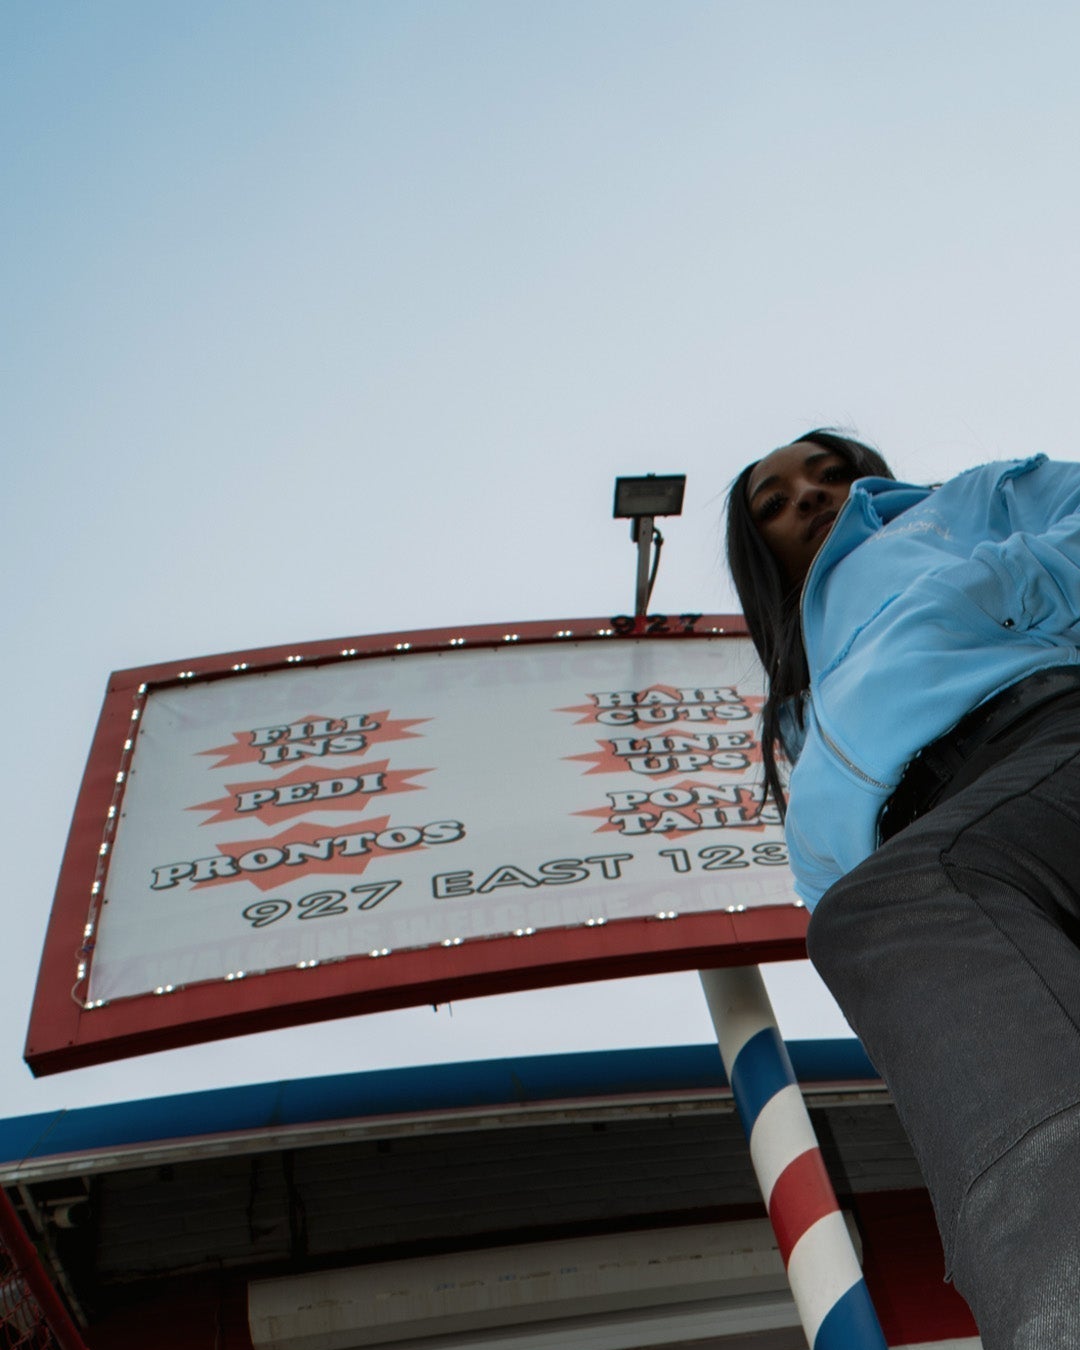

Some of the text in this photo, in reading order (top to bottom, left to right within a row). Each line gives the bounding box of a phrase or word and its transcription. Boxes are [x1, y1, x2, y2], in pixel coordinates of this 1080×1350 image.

[610, 614, 703, 635] 927
[592, 686, 746, 709] HAIR
[594, 703, 753, 726] CUTS
[249, 714, 380, 747] FILL
[608, 731, 756, 757] LINE
[258, 734, 367, 765] INS
[625, 751, 751, 775] UPS
[234, 771, 389, 813] PEDI
[149, 820, 467, 891] PRONTOS
[241, 879, 403, 928] 927
[431, 853, 634, 900] EAST
